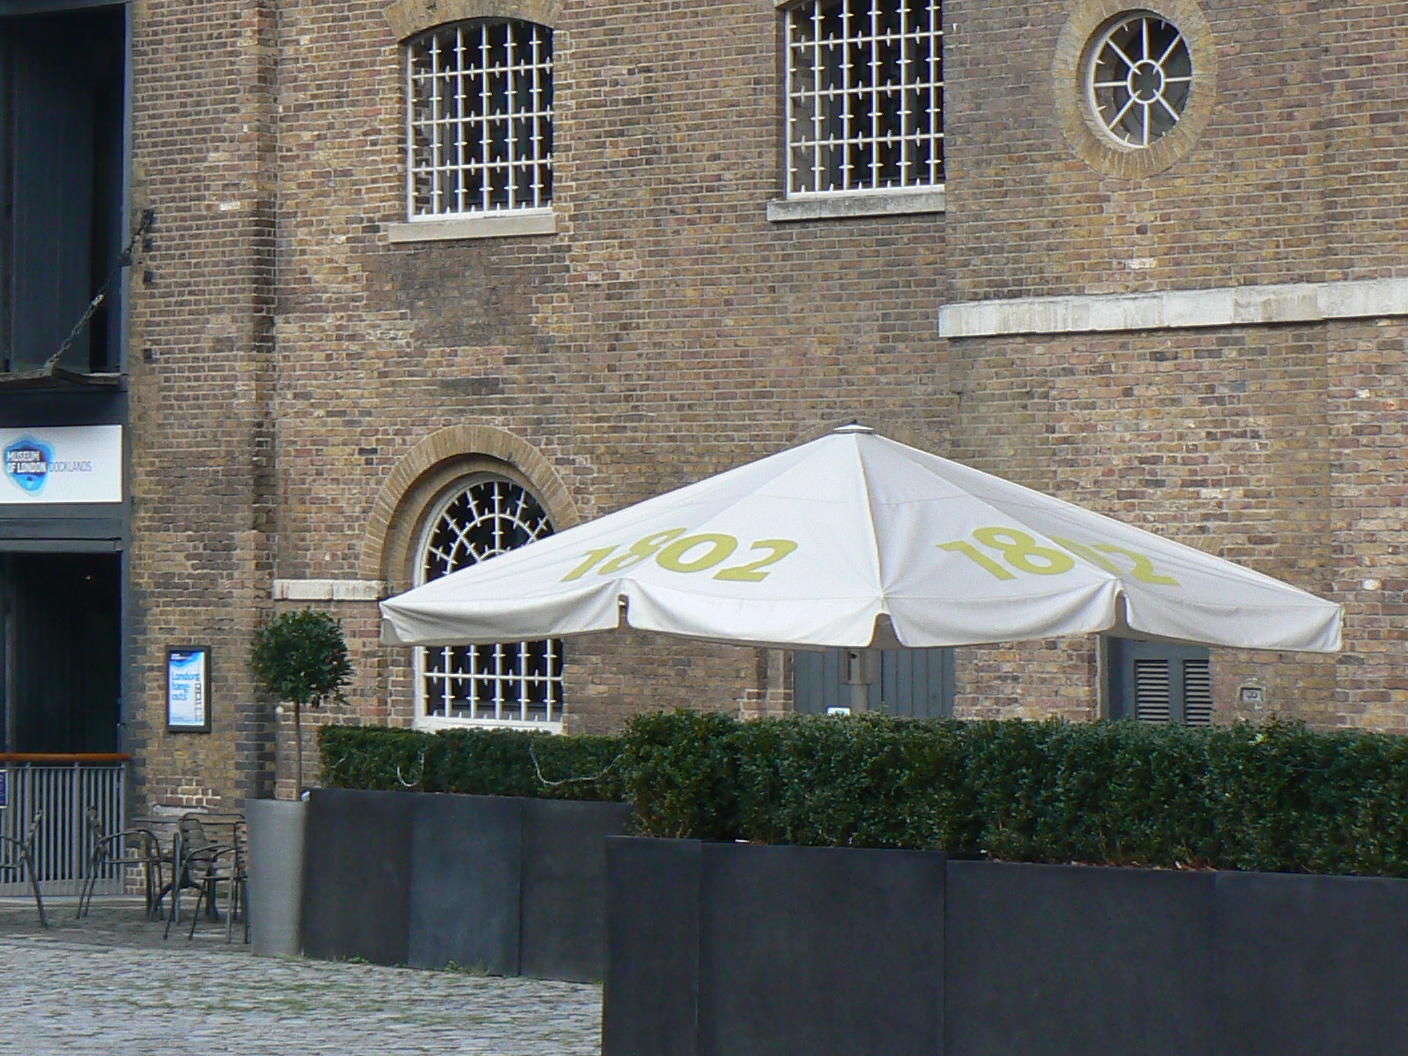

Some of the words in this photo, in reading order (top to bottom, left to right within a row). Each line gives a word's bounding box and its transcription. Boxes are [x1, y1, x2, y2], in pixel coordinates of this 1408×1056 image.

[7, 450, 40, 461] MUSEUM
[7, 462, 16, 473] OF
[17, 461, 46, 473] LONDON
[49, 460, 92, 472] DOCKLANDS
[559, 527, 798, 582] 1802
